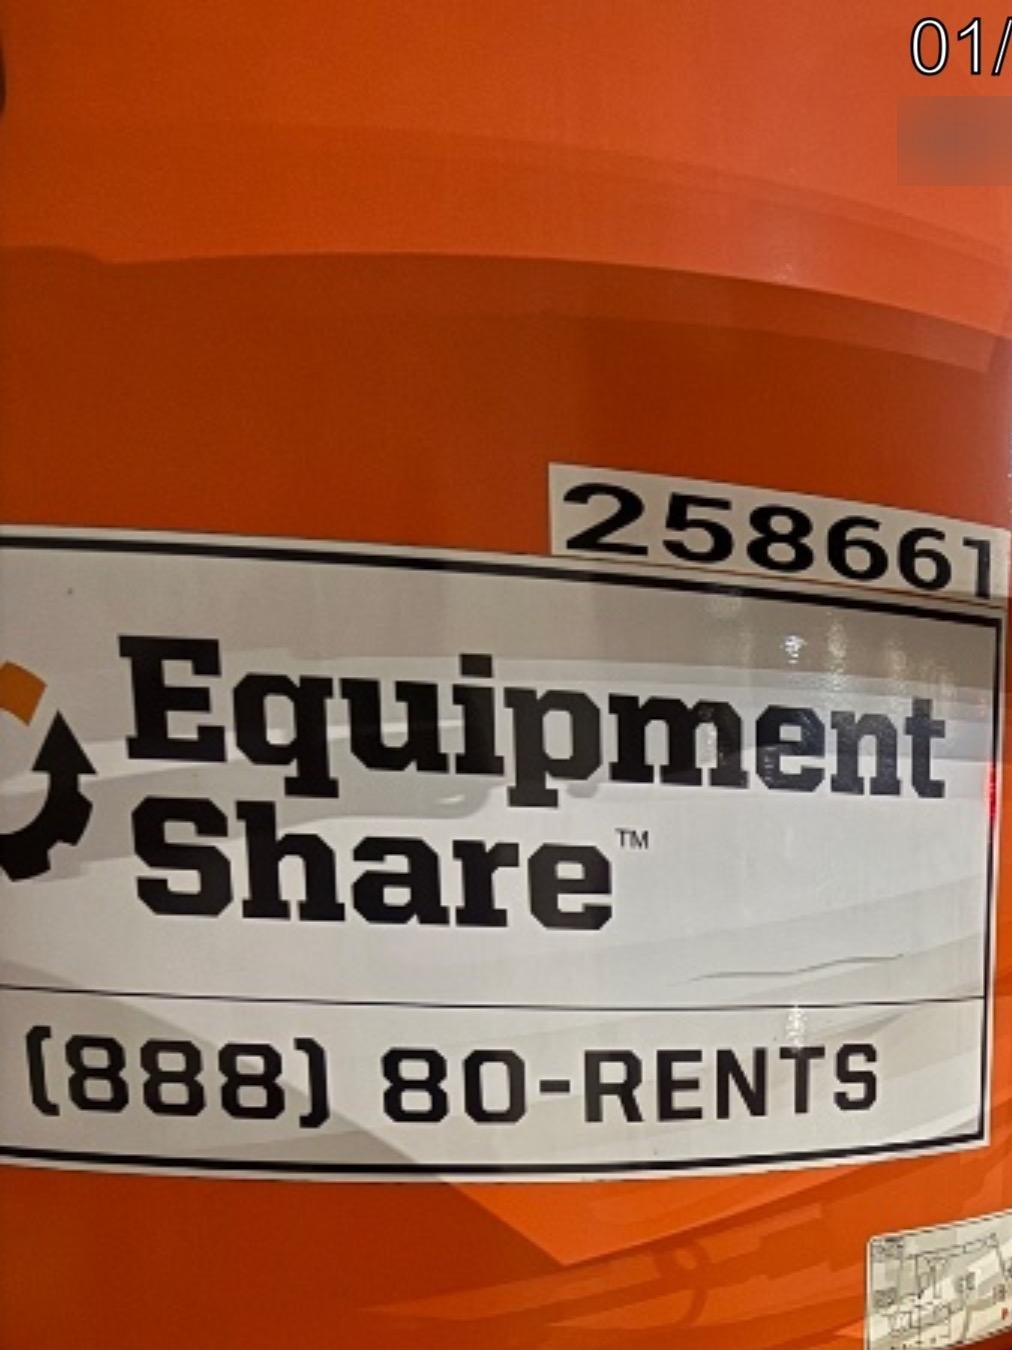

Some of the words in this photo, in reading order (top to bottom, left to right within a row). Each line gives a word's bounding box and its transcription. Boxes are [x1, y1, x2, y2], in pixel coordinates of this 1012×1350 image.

[563, 481, 993, 600] 258661
[118, 634, 946, 808] Equipment
[132, 796, 613, 930] Share
[25, 1025, 331, 1129] (888)
[381, 1043, 880, 1125] 80-RENTS
